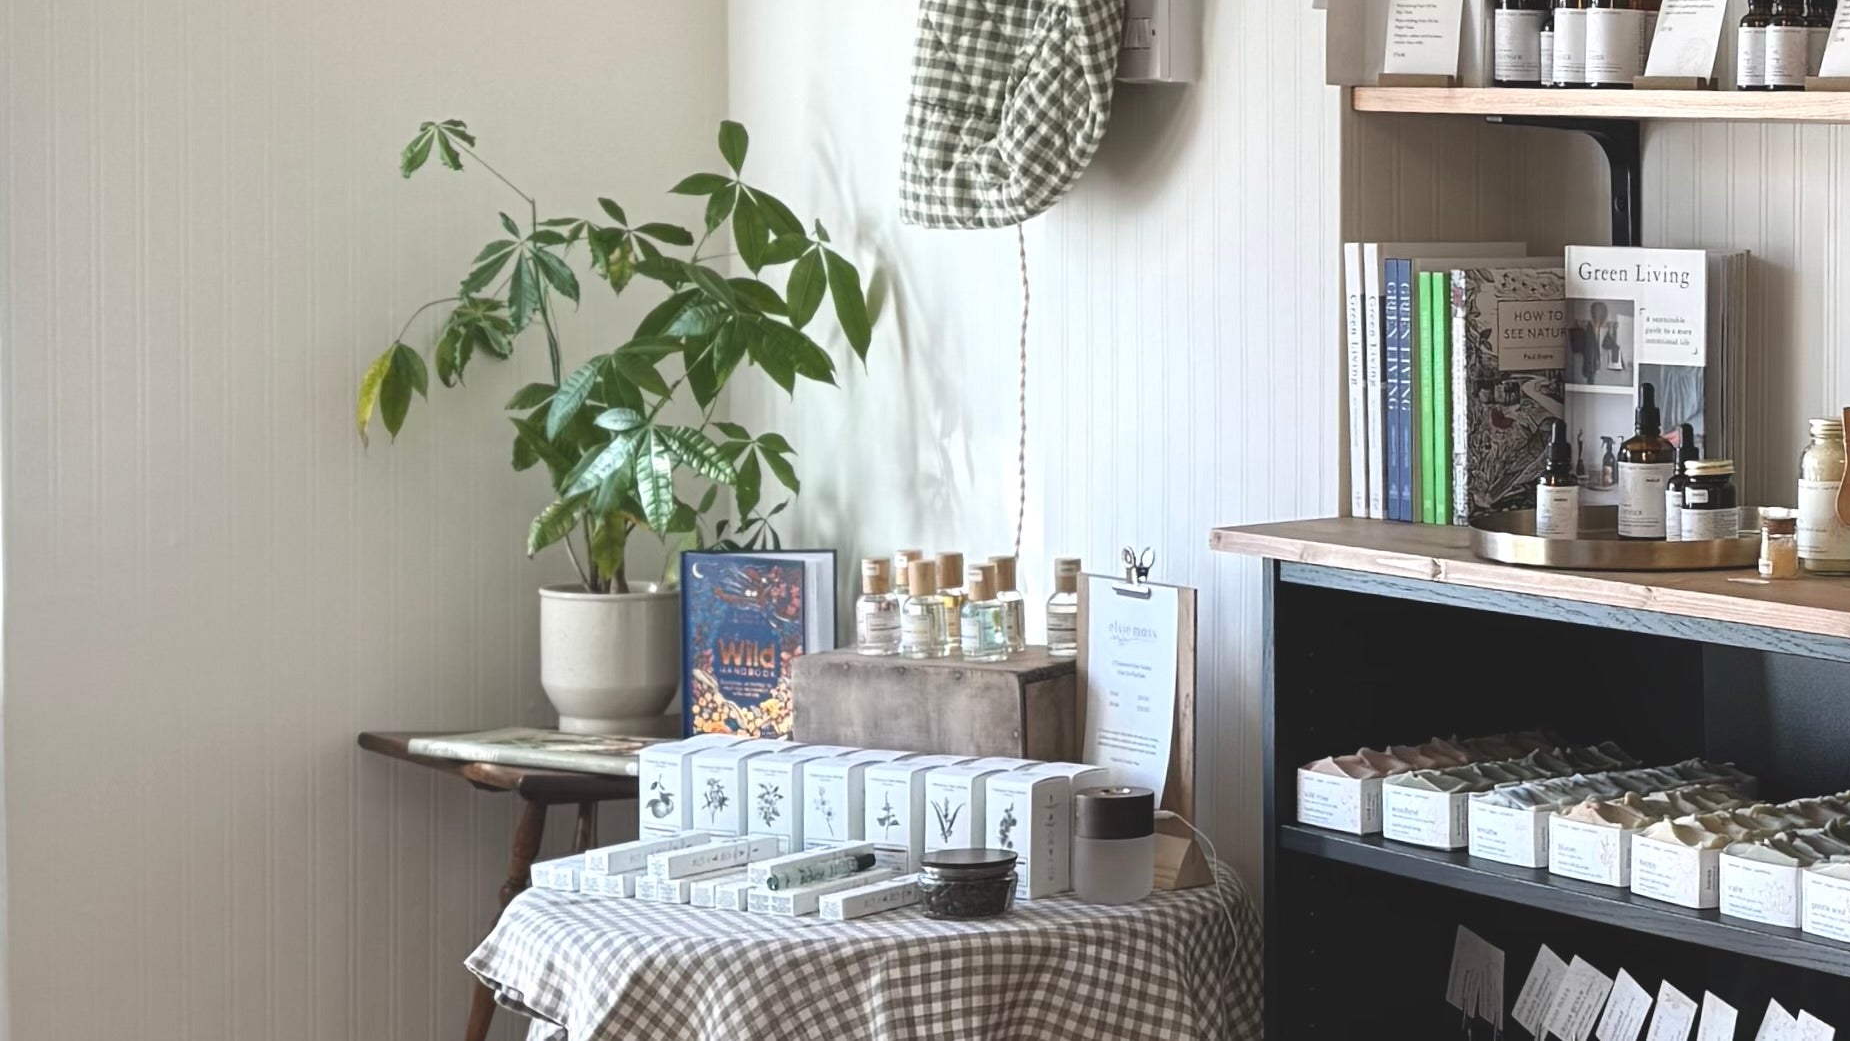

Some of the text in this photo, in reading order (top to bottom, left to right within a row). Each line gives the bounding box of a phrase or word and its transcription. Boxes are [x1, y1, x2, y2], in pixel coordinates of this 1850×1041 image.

[1578, 262, 1690, 289] Green Living
[1514, 310, 1564, 321] HOW TO
[1387, 282, 1398, 410] GREEN LIVING
[1400, 282, 1411, 411] GREEN LIVING
[1503, 328, 1566, 339] SEE NATUR
[1351, 341, 1359, 386] Living
[717, 638, 775, 669] Wild
[719, 668, 777, 678] HANDBOOK
